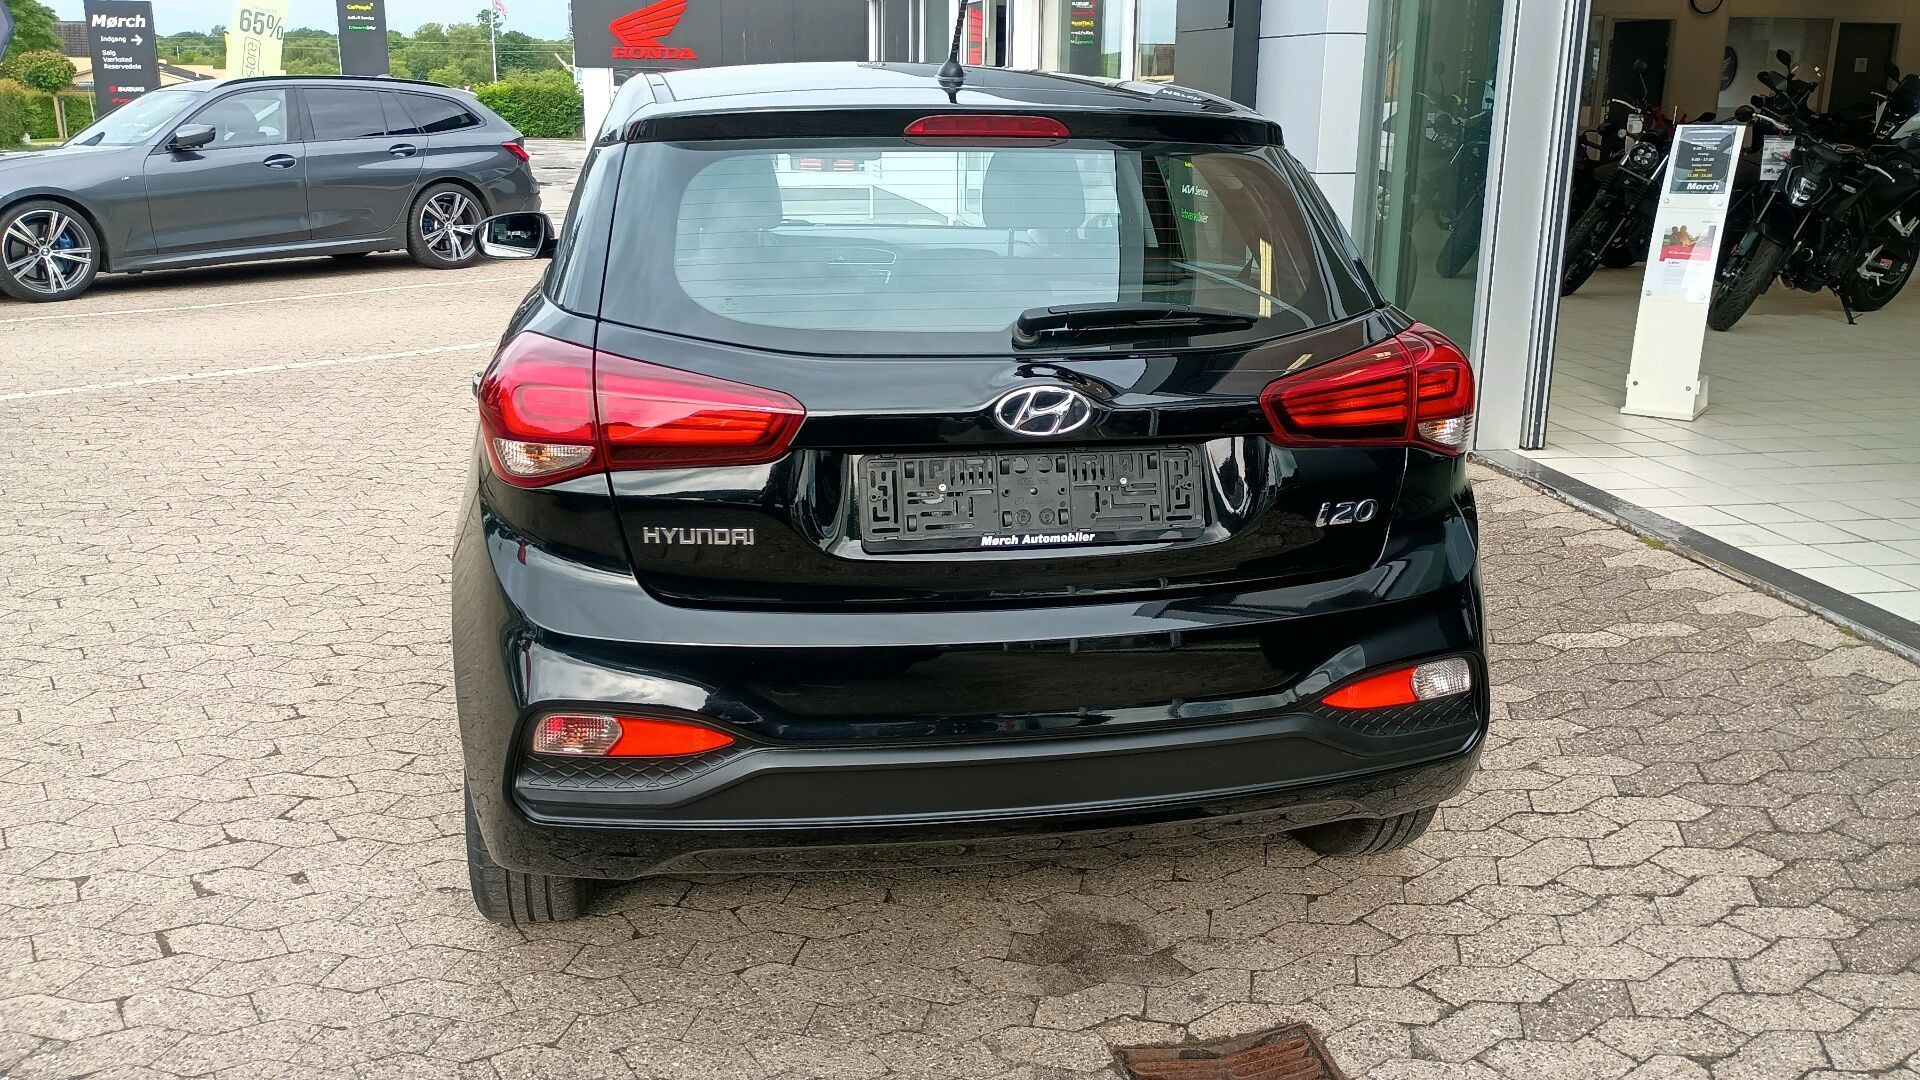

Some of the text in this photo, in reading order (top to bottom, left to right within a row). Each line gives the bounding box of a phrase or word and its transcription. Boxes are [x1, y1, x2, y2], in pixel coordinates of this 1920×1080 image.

[91, 14, 146, 28] Mørch
[240, 9, 284, 41] 65%
[611, 47, 698, 60] HONDA
[643, 527, 755, 546] HYUNDAI
[981, 532, 1096, 546] Mørch Automobiler
